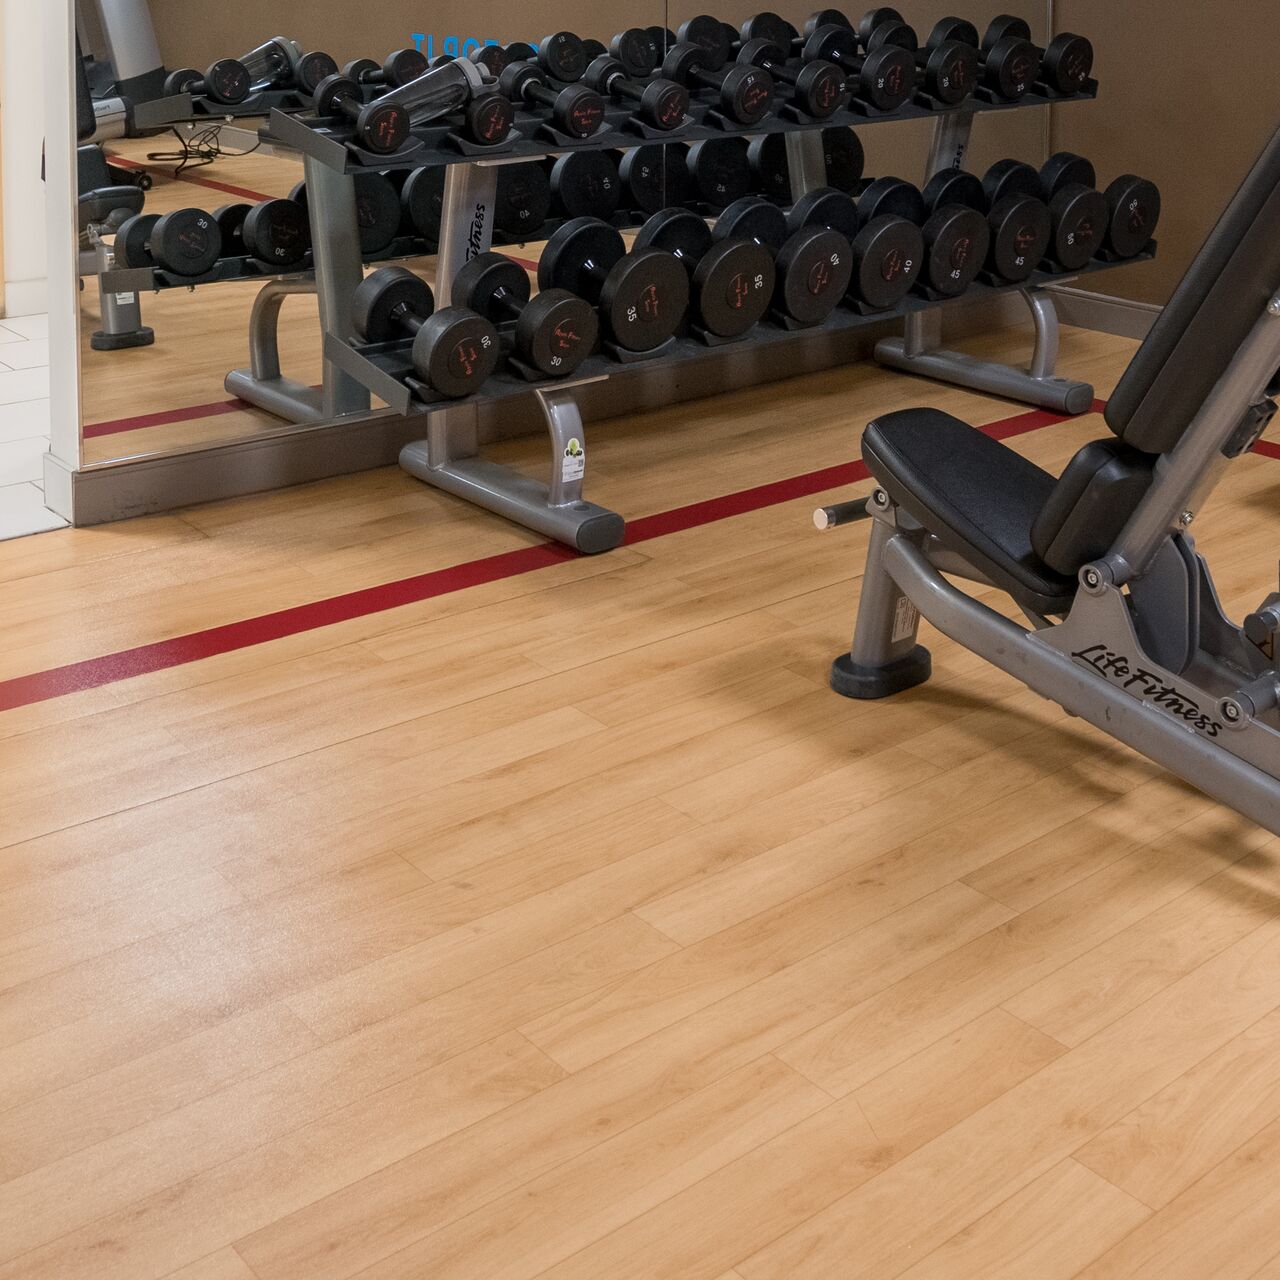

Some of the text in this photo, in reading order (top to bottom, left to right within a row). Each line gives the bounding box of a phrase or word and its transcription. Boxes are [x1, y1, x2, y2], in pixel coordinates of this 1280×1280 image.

[904, 259, 913, 273] 40
[1015, 256, 1025, 266] 45
[754, 274, 763, 289] 35
[950, 270, 961, 279] 45
[627, 305, 637, 322] 35
[480, 335, 491, 349] 30
[550, 355, 562, 366] 30
[1071, 644, 1223, 737] Life Fitness
